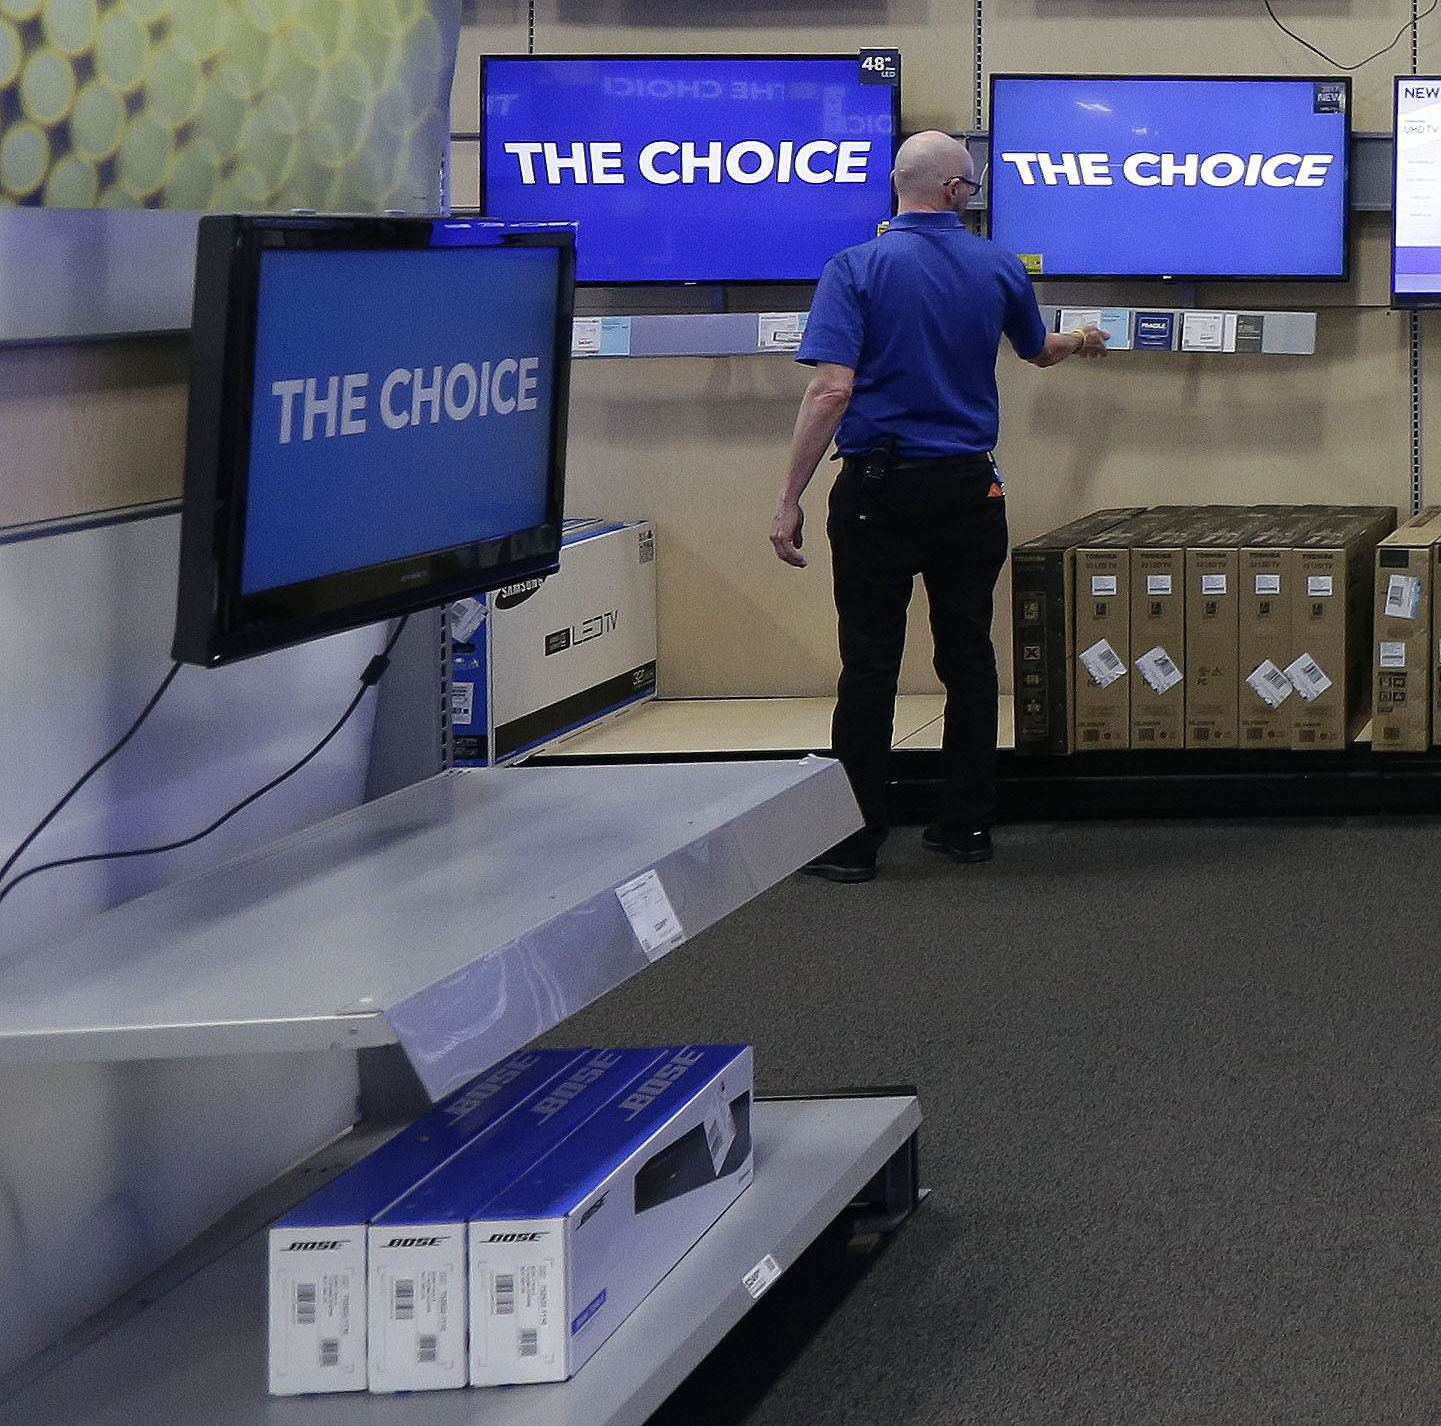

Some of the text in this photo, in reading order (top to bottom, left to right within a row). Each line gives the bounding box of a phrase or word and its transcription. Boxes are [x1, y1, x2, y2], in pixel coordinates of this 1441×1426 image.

[862, 56, 886, 72] 48
[1405, 87, 1440, 99] NEW
[1426, 125, 1439, 134] TV
[505, 140, 872, 185] THE CHOICE
[1002, 152, 1334, 188] THE CHOICE
[272, 357, 540, 444] THE CHOICE
[443, 1051, 541, 1126] BOSE
[528, 1048, 623, 1126] BOSE
[618, 1044, 704, 1122] BOSE
[279, 1239, 351, 1252] BOSE
[380, 1235, 451, 1249] BOSE
[478, 1231, 551, 1244] BOSE
